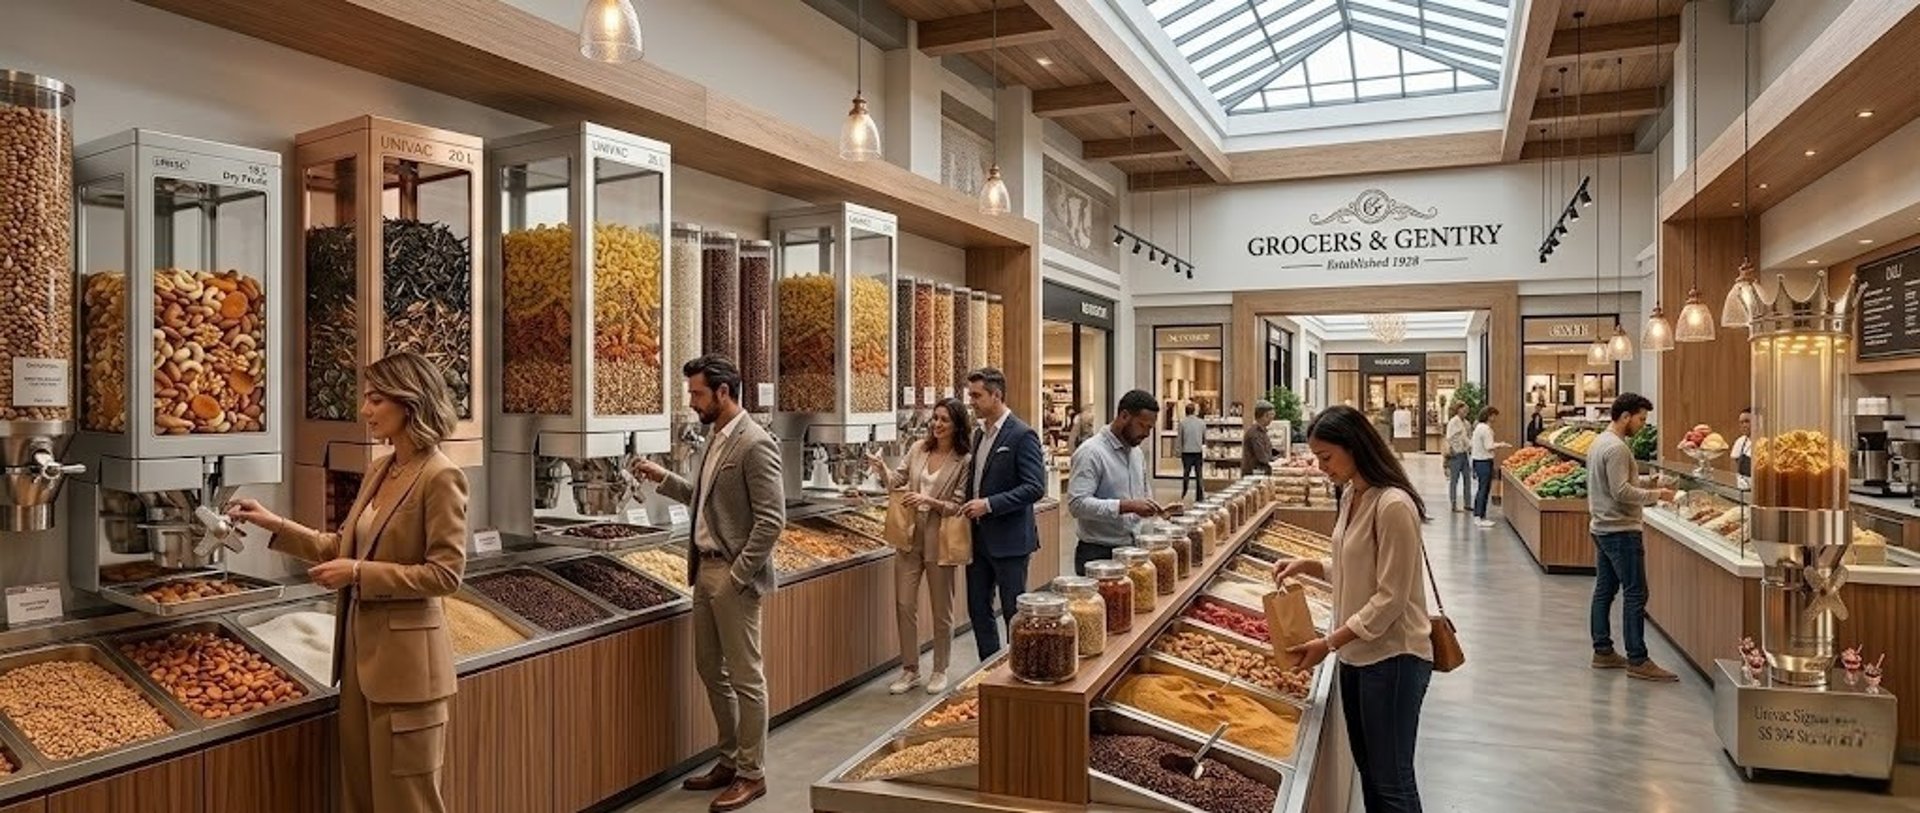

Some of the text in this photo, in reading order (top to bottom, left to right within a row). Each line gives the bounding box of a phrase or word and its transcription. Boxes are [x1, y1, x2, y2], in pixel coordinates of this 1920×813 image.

[380, 135, 474, 165] UNIVAC 20 L
[1247, 224, 1504, 256] GROCERS & GENTRY
[1326, 255, 1420, 271] Established 1928
[1754, 705, 1791, 721] Univac
[1758, 726, 1773, 741] SS
